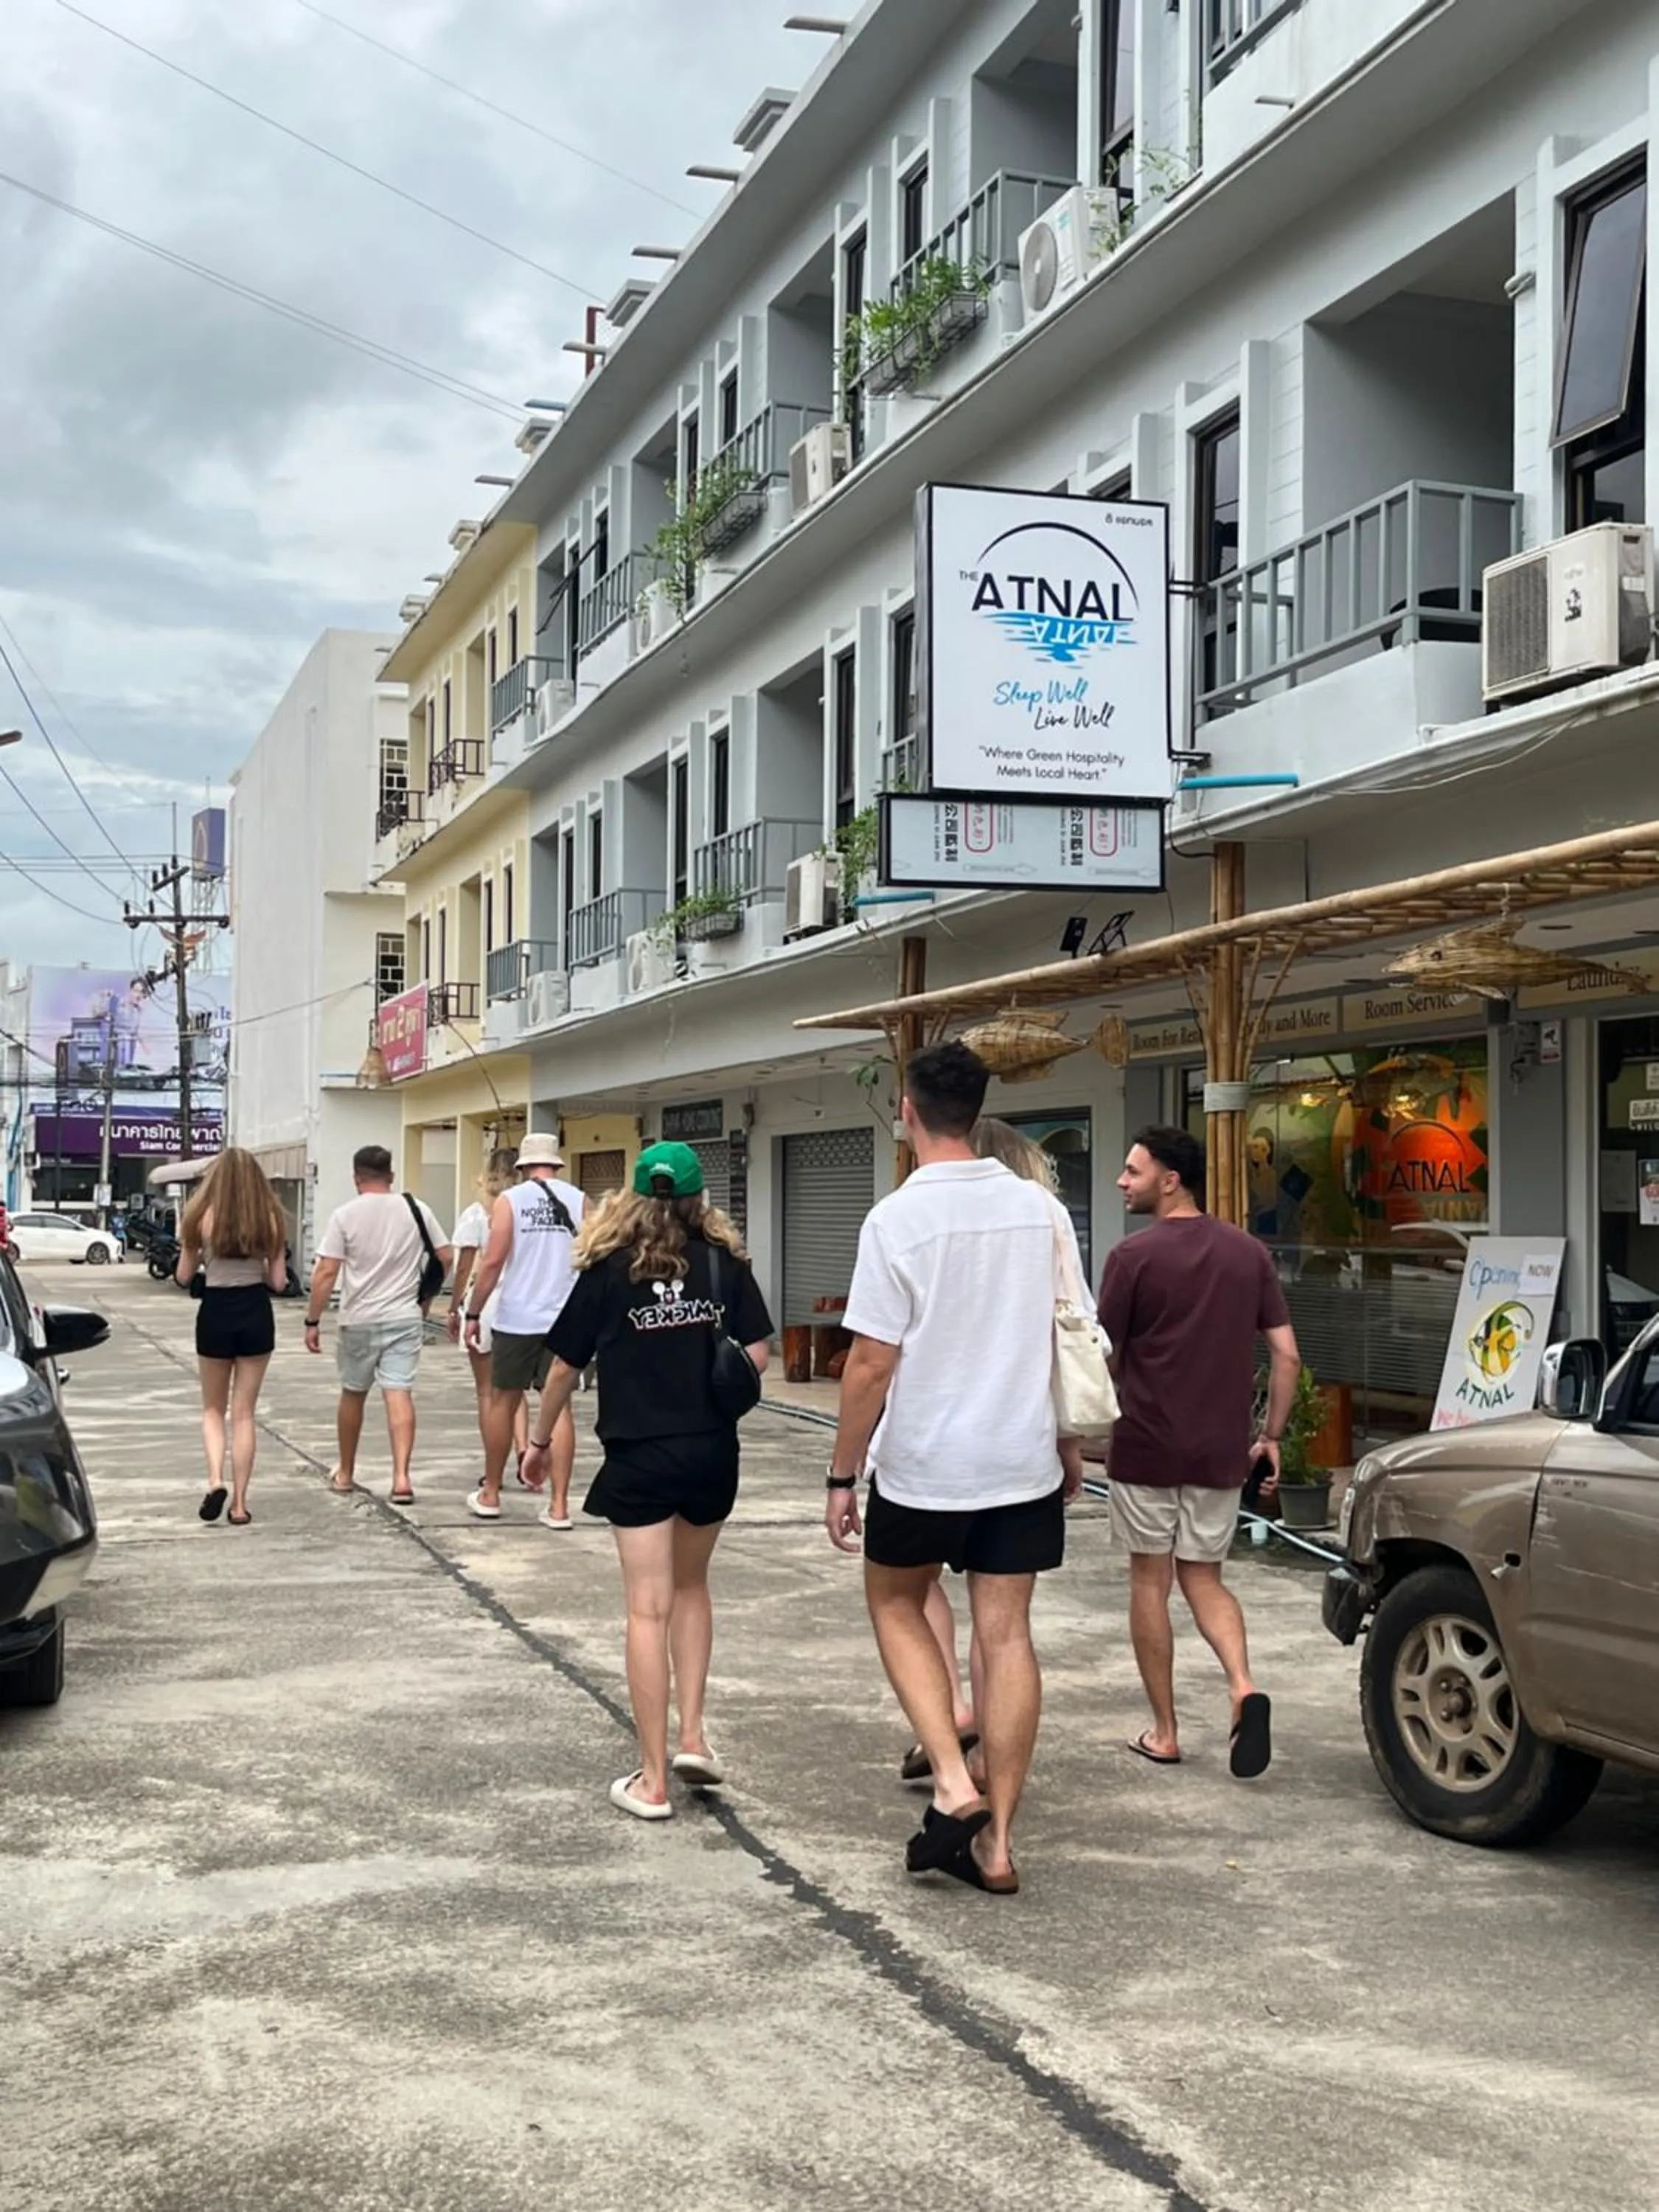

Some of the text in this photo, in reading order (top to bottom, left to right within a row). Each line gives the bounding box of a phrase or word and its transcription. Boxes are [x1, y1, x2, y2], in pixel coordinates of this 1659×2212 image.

[959, 570, 978, 582] THE
[971, 572, 1134, 622] ATNAL
[993, 676, 1089, 712] Sleep Well
[1034, 701, 1116, 730] Live Well
[1026, 748, 1062, 761] Green
[1066, 750, 1124, 768] Hospitality
[997, 764, 1032, 777] Meets
[1276, 1009, 1296, 1032] and
[1300, 1008, 1332, 1029] More
[1365, 999, 1403, 1020] Room
[1133, 1034, 1160, 1051] Room
[140, 1141, 164, 1151] Siam
[1388, 1159, 1470, 1193] ATNAL
[1528, 1264, 1554, 1278] NOW
[1456, 1377, 1514, 1409] ATNAL
